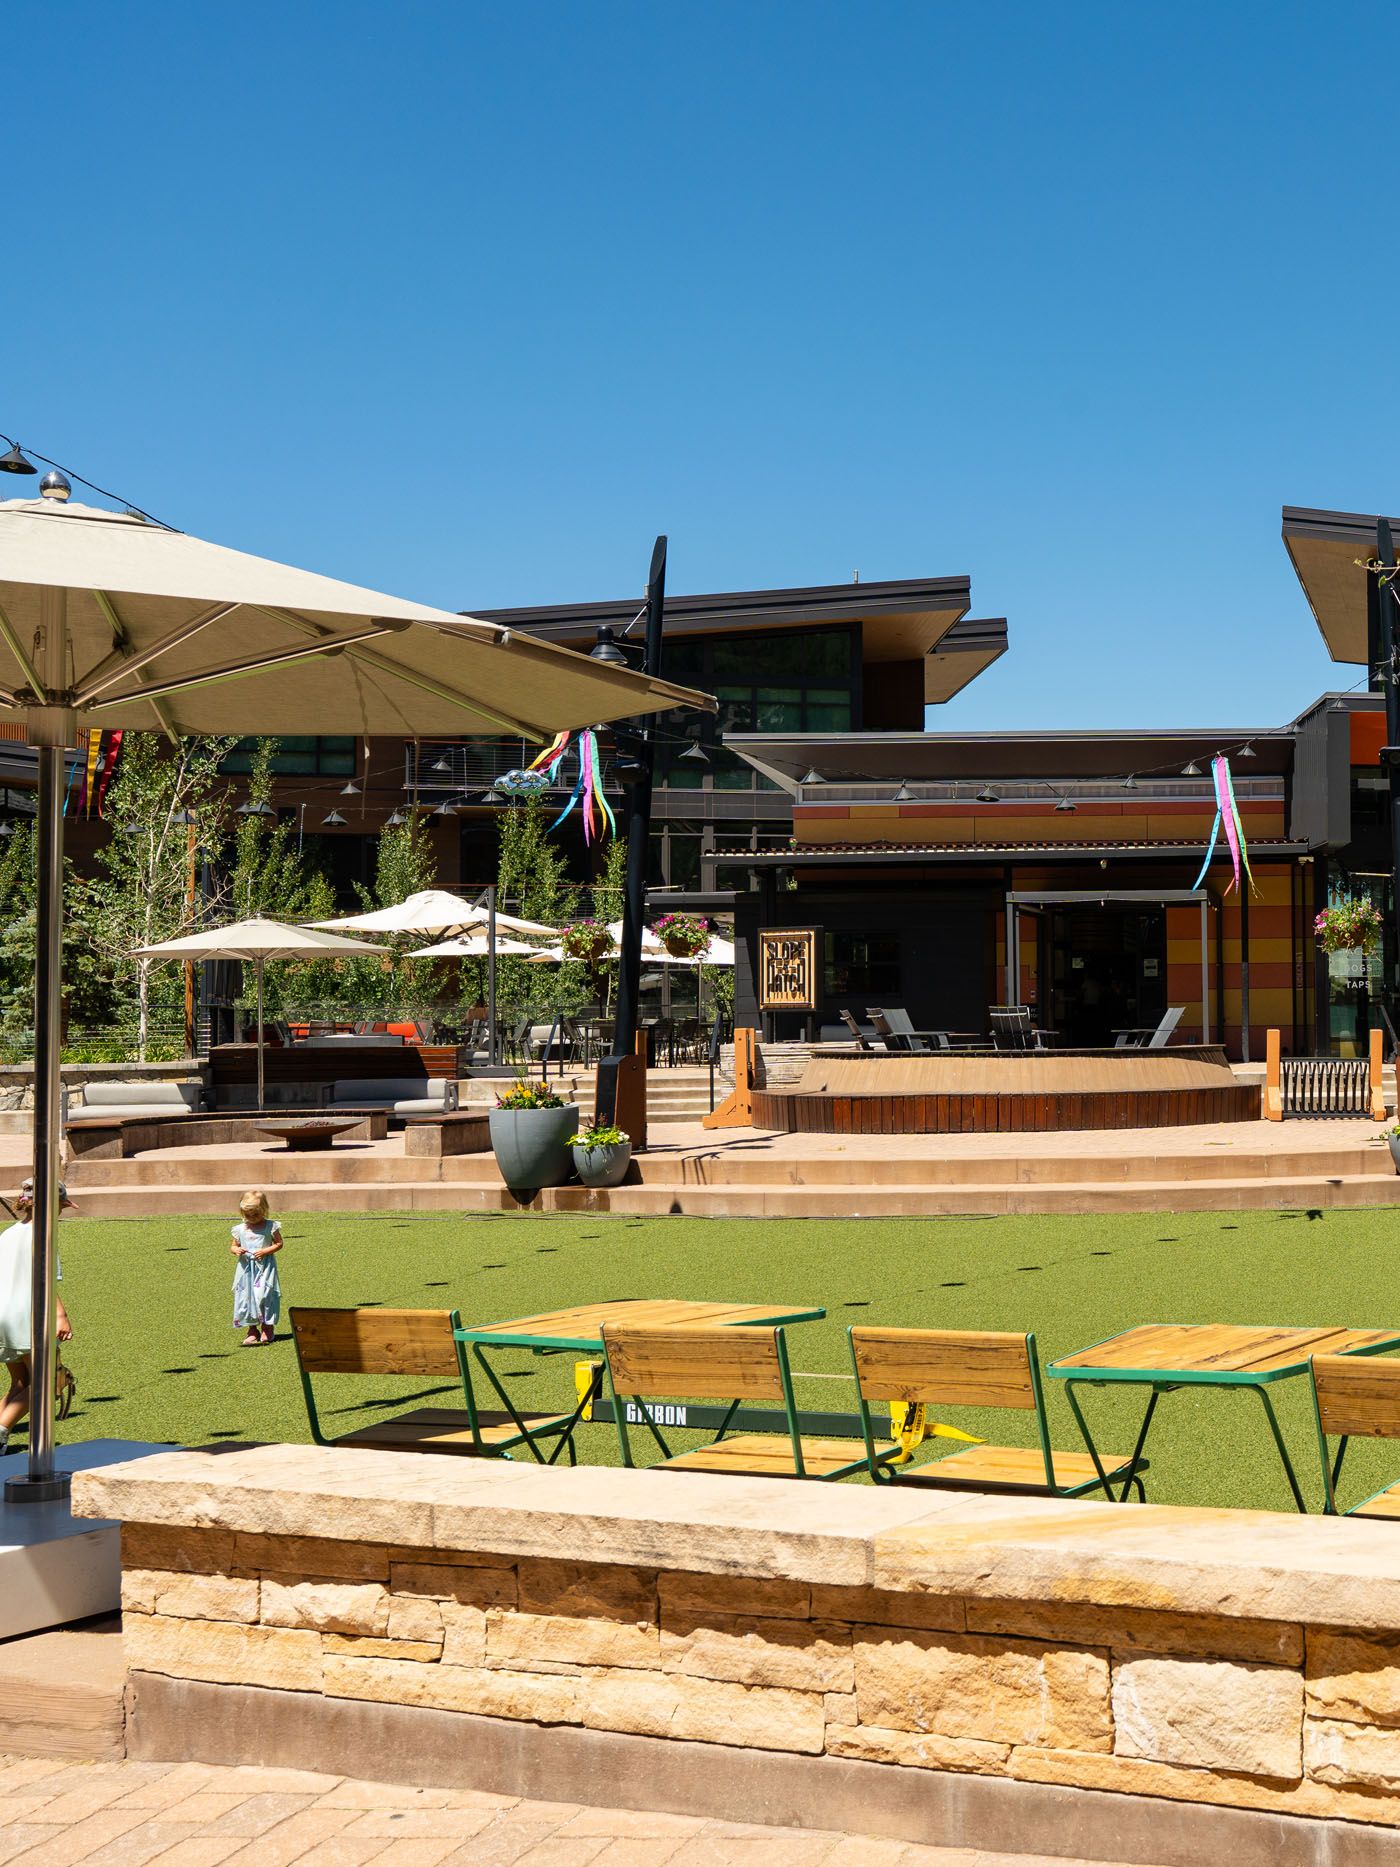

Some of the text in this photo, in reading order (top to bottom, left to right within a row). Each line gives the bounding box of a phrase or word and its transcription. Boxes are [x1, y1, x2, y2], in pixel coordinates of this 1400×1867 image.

[767, 941, 806, 960] SLOPE
[767, 957, 806, 998] HATCH
[1346, 980, 1371, 989] TAPS
